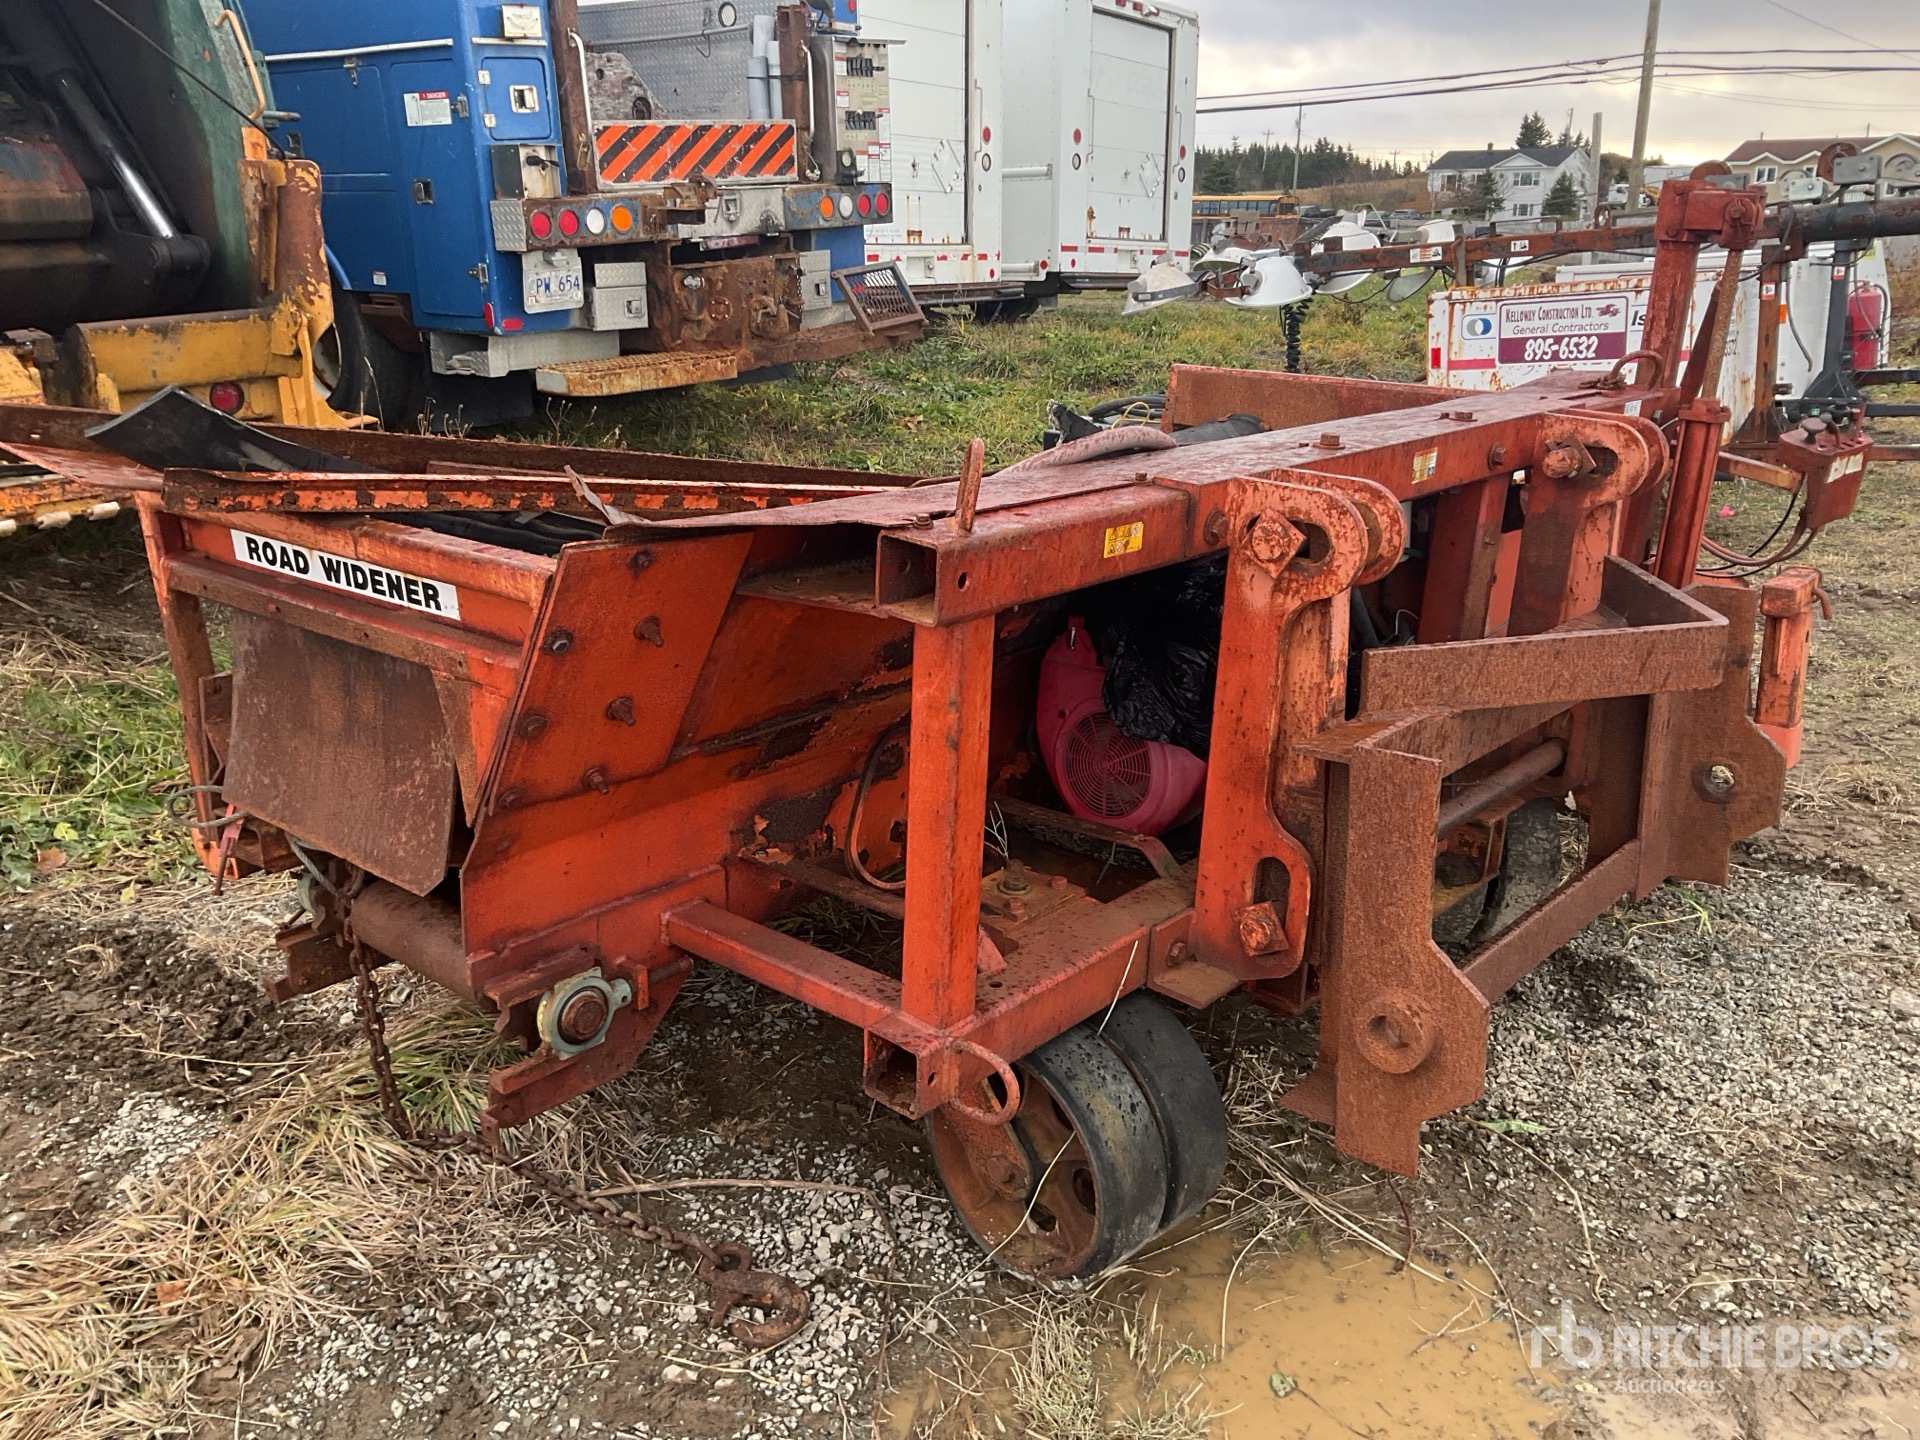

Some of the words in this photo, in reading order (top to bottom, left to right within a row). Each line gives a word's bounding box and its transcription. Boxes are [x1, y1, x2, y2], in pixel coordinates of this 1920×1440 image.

[536, 277, 550, 294] PW
[558, 275, 580, 291] 654
[1538, 306, 1579, 321] CONSTRUCTION
[1581, 304, 1594, 319] LTD.
[1512, 324, 1549, 335] General
[1551, 321, 1609, 333] Contractors
[1524, 335, 1599, 361] 895-6532
[245, 536, 310, 575] ROAD
[318, 555, 442, 611] WIDENER
